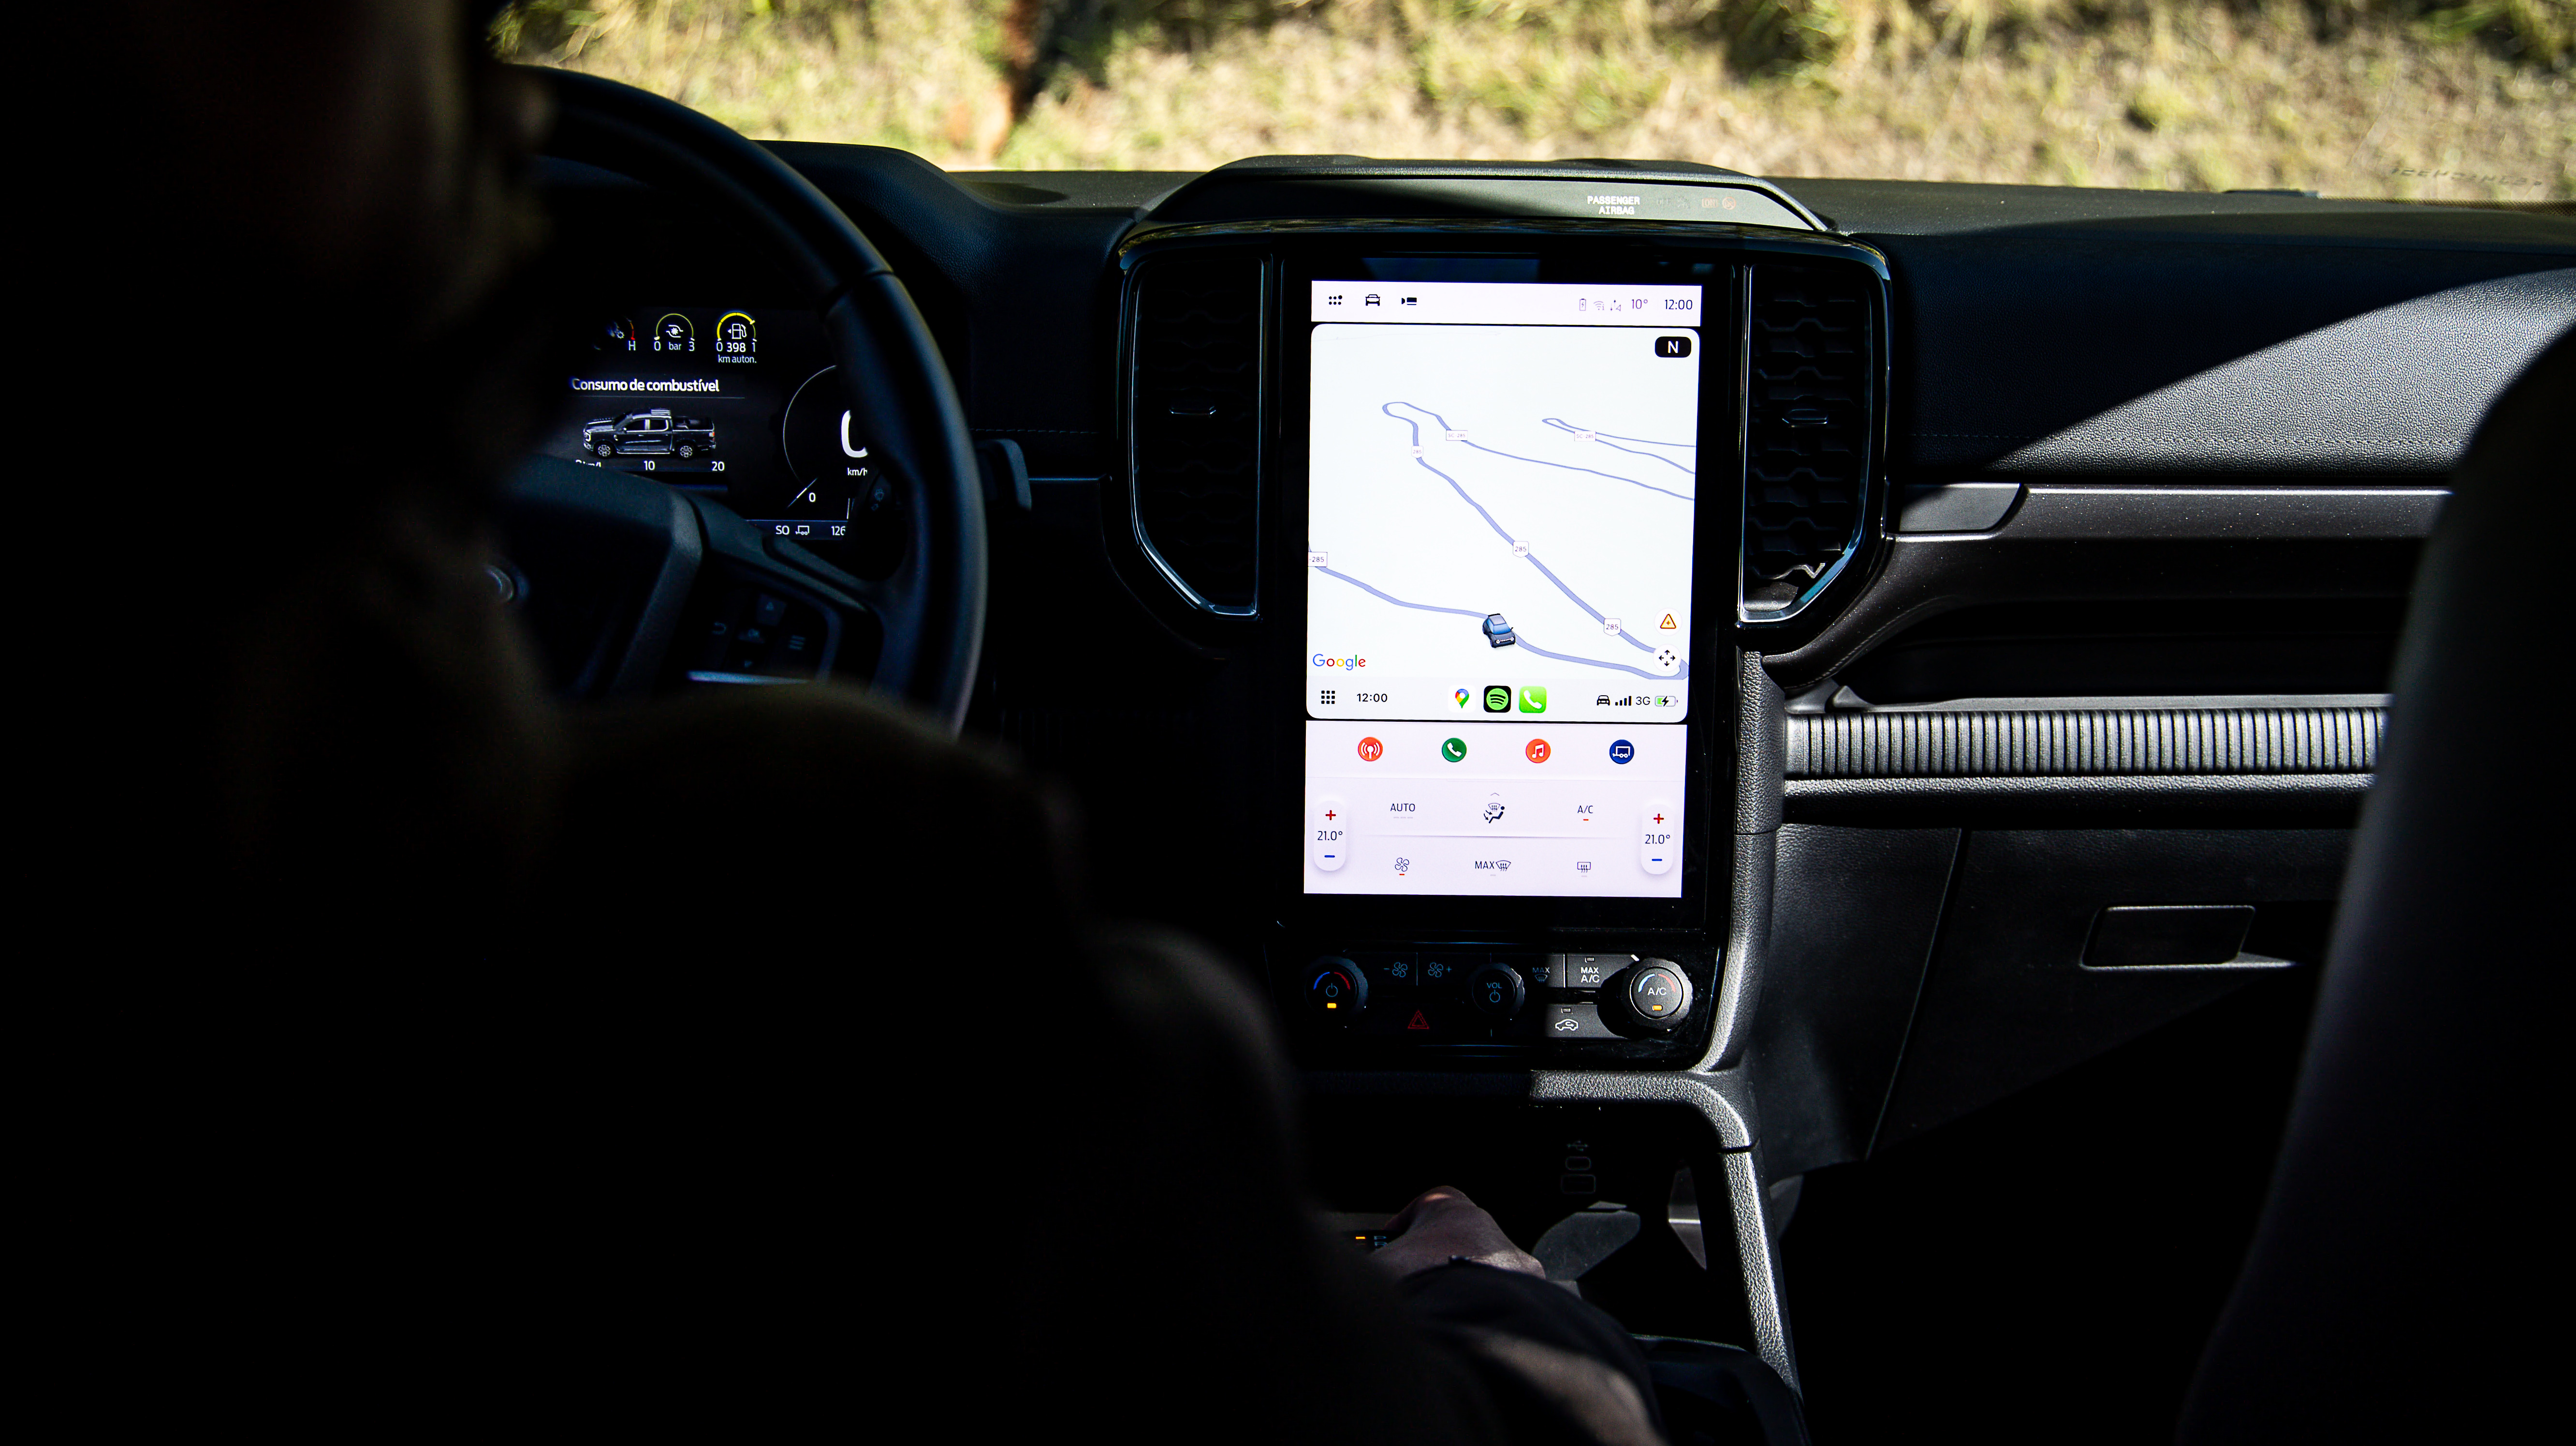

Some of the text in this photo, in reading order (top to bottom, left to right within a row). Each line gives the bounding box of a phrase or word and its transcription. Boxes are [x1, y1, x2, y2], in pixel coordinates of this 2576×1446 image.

[1587, 195, 1640, 205] PASSENGER
[1598, 205, 1635, 215] AIRBAG
[1631, 299, 1648, 309] 10°
[1665, 299, 1693, 310] 12:00
[628, 340, 636, 351] H
[654, 341, 661, 351] 0
[668, 341, 682, 351] bar
[688, 341, 695, 351] 3
[727, 342, 746, 352] 398
[1668, 340, 1679, 353] N
[718, 354, 757, 363] km auton.
[572, 378, 720, 392] Consumo de combustível
[644, 460, 656, 470] 10
[711, 461, 725, 471] 20
[808, 492, 816, 502] 0
[776, 525, 790, 535] SO
[1313, 654, 1366, 671] Google
[1357, 693, 1388, 702] 12:00
[1636, 696, 1651, 705] 3G
[1390, 803, 1416, 812] AUTO
[1577, 805, 1593, 814] A/C
[1317, 831, 1343, 841] 21.0°
[1645, 834, 1670, 844] 21.0°
[1475, 861, 1494, 869] MAX
[1581, 974, 1600, 983] A/C
[1647, 987, 1667, 996] A/C
